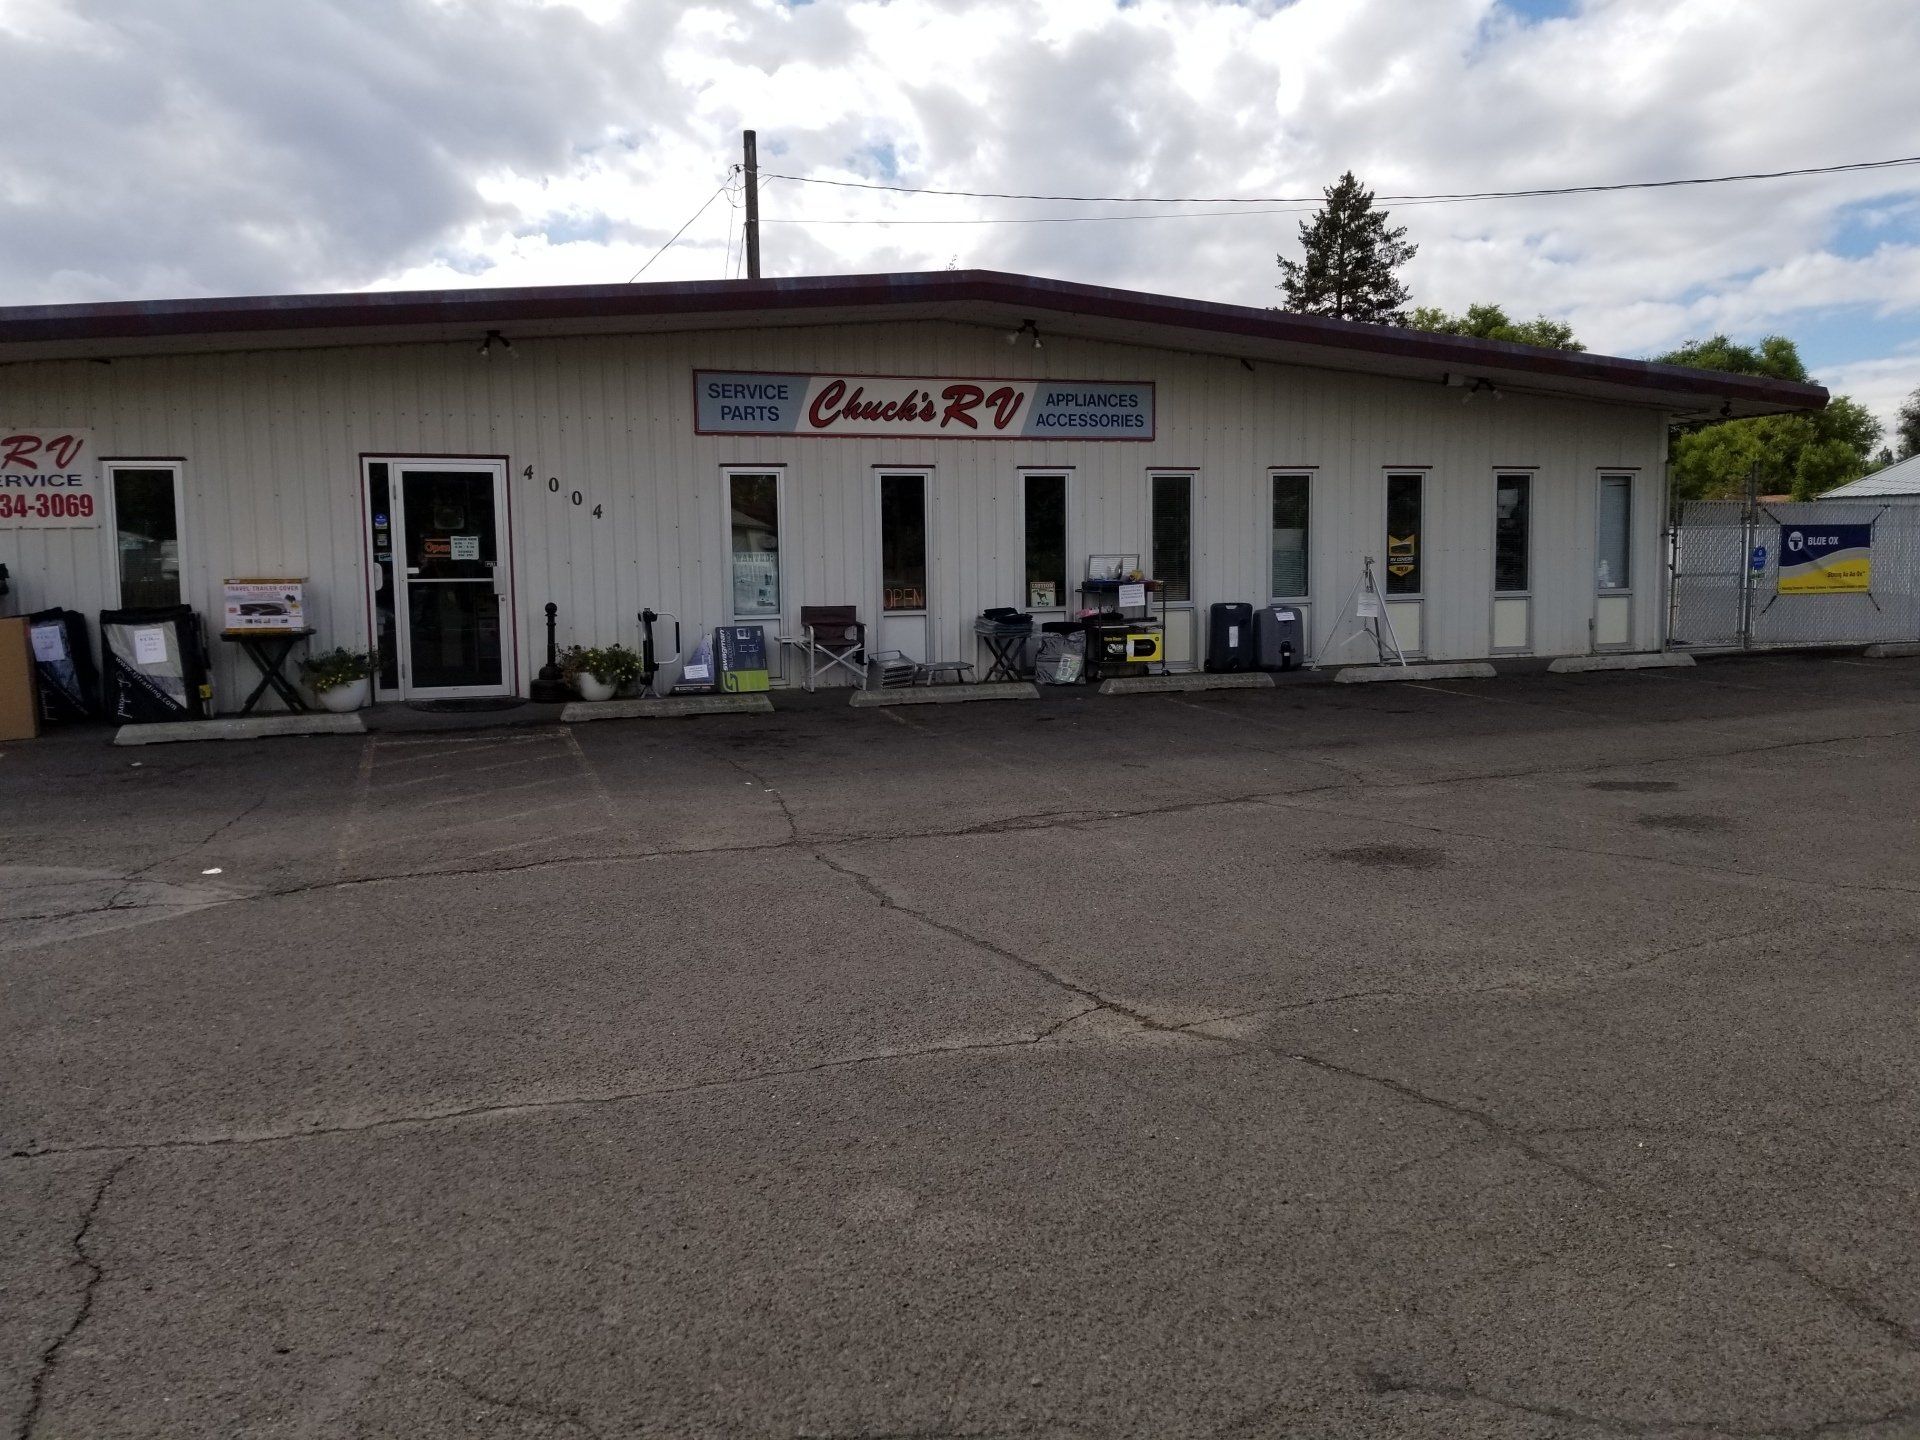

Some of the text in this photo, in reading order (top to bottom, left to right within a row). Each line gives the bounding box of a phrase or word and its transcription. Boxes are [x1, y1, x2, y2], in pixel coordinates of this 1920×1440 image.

[707, 382, 789, 400] SERVICE
[808, 379, 1025, 430] Chuck's RV
[1045, 393, 1138, 408] APPLIANCES
[720, 405, 780, 422] PARTS
[1036, 413, 1144, 428] ACCESSORIES
[0, 434, 84, 470] RV
[0, 474, 82, 487] RVICE
[1828, 536, 1839, 545] OX
[885, 587, 923, 609] OPEN
